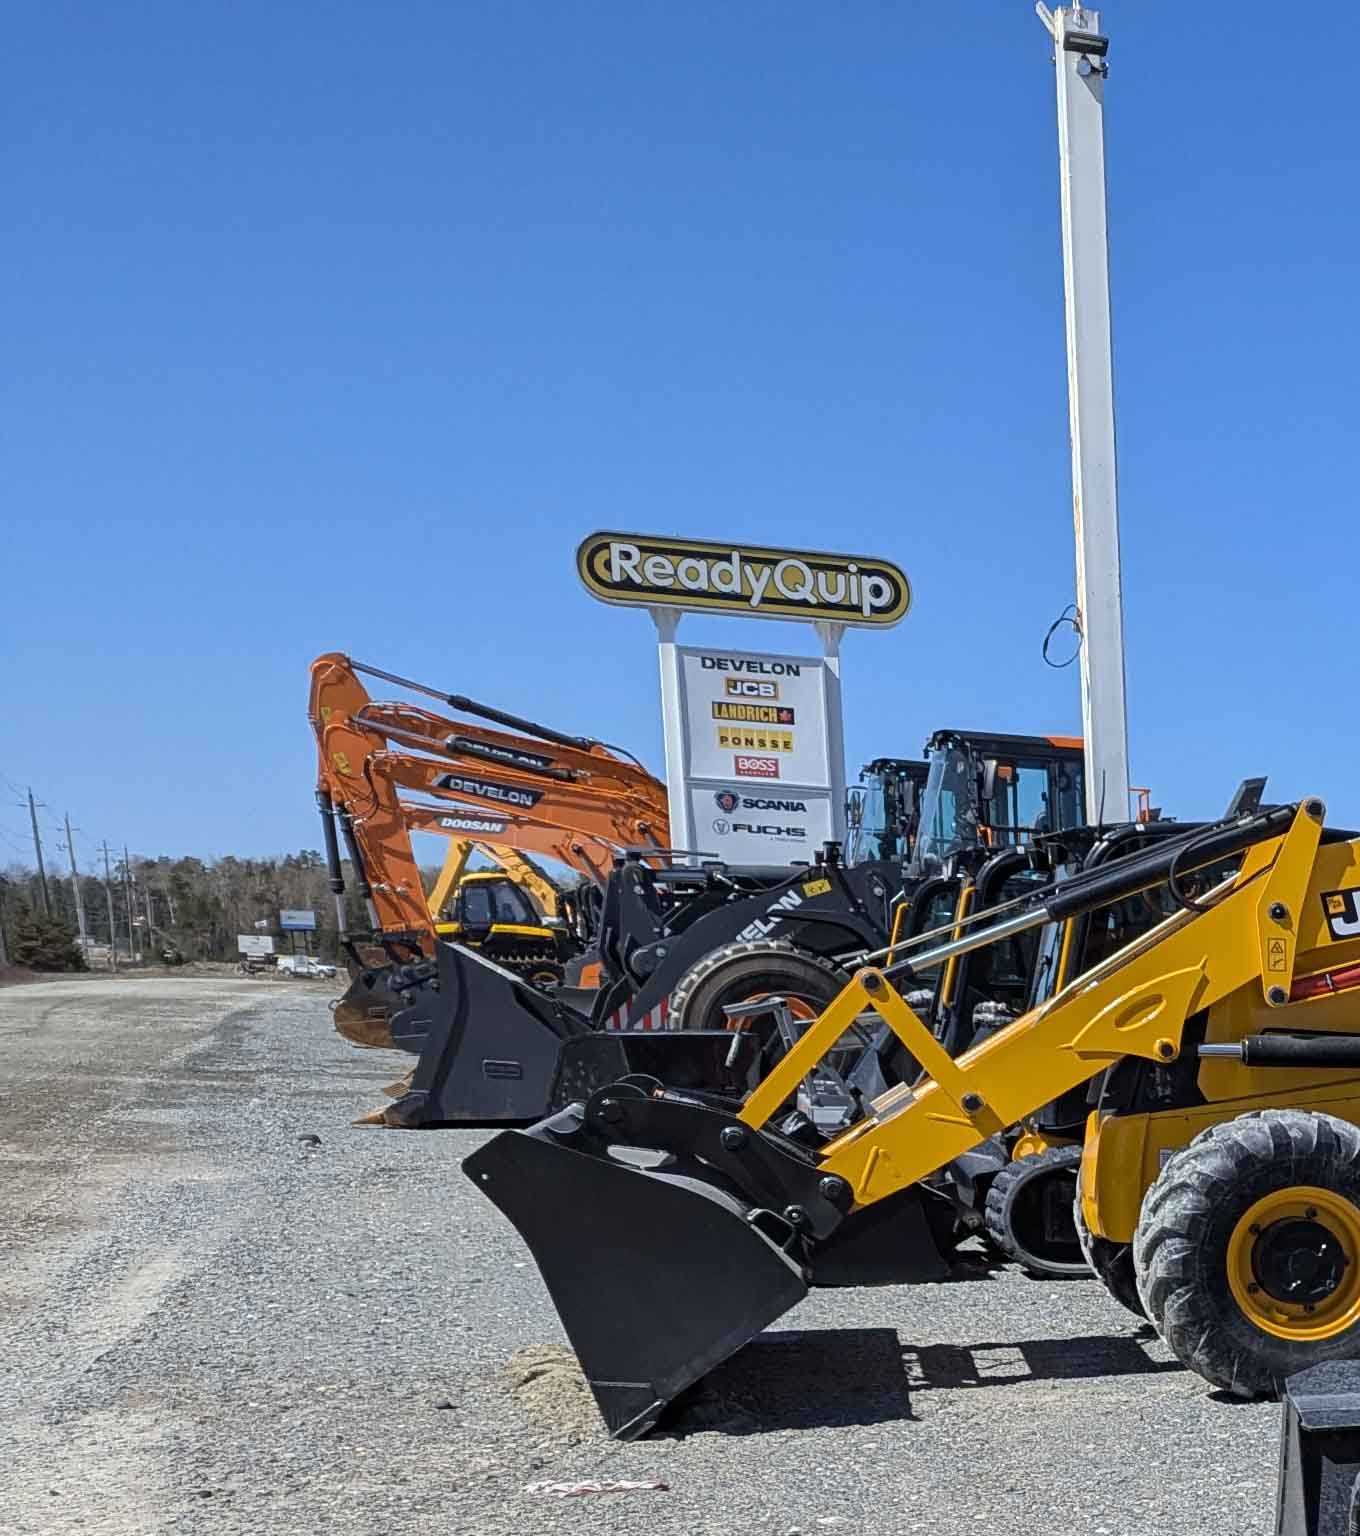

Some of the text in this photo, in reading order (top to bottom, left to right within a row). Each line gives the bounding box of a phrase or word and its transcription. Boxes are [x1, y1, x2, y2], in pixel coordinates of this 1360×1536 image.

[609, 541, 893, 617] ReadyQuip
[700, 656, 801, 677] DEVELON
[728, 680, 776, 697] JCB
[713, 702, 778, 722] LANDRICH
[719, 735, 792, 750] PONSSE
[738, 758, 776, 771] BOSS
[449, 777, 534, 806] DEVELON
[742, 798, 807, 813] SCANIA
[440, 816, 504, 833] DOOSAN
[732, 823, 807, 837] FUCHS
